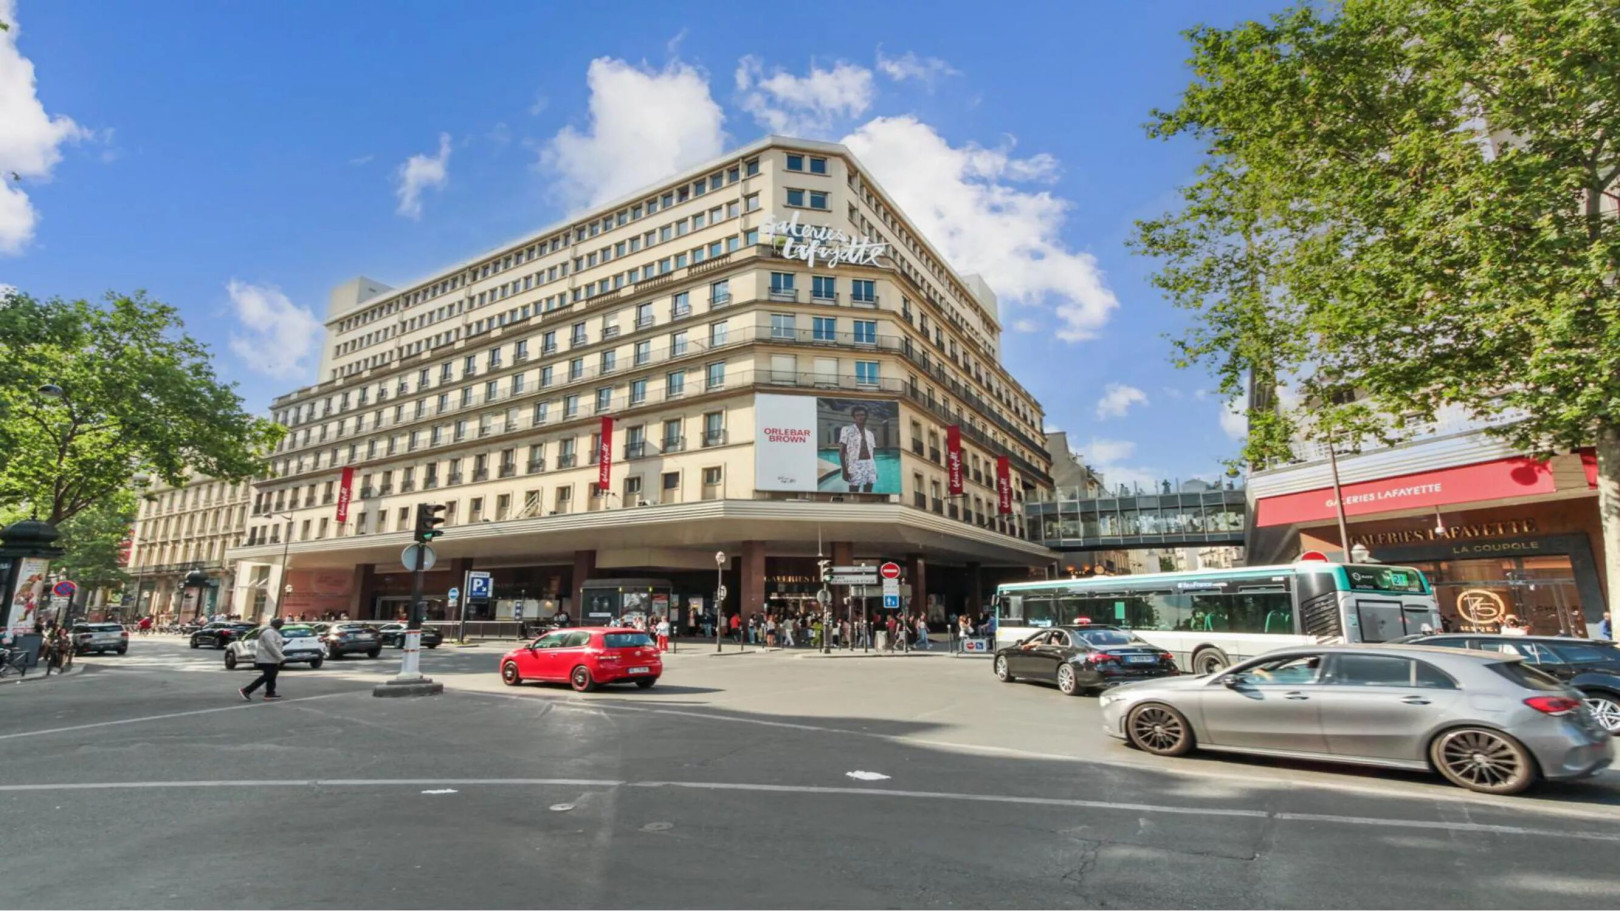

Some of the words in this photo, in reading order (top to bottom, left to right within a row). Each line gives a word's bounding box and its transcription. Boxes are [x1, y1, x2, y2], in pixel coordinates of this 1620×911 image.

[783, 235, 890, 268] Lafayette
[764, 428, 811, 436] ORLEBAR
[769, 435, 806, 443] BROWN
[1377, 483, 1442, 499] LAFAYETTE
[1350, 529, 1424, 546] GALERIES
[1428, 520, 1536, 540] LAFAYETTE
[1453, 546, 1469, 554] LA
[1474, 541, 1540, 552] COUPOLE
[473, 579, 484, 591] P
